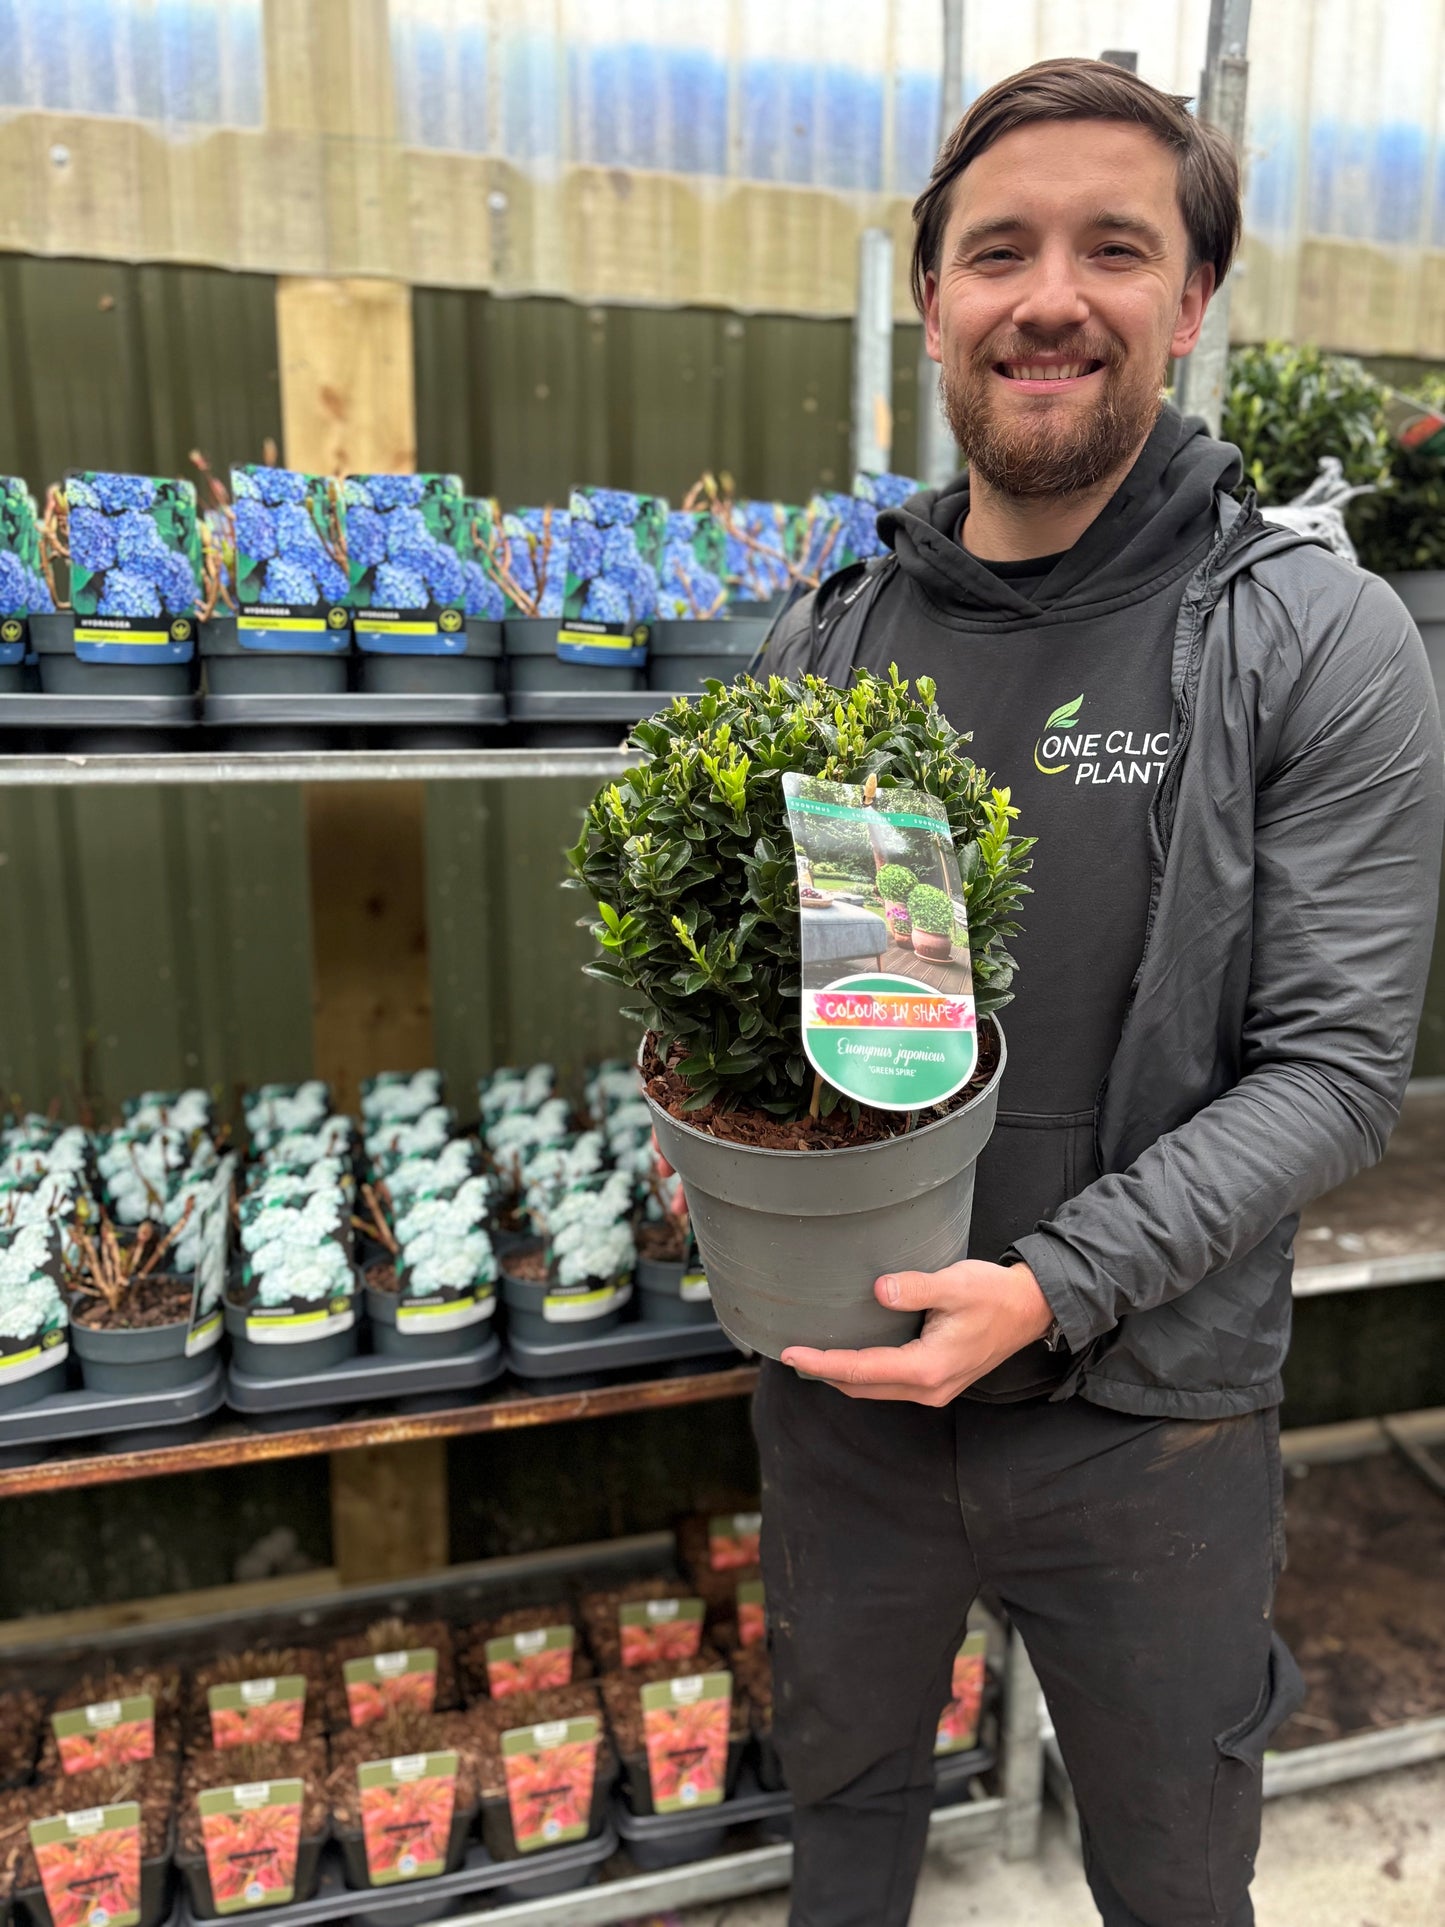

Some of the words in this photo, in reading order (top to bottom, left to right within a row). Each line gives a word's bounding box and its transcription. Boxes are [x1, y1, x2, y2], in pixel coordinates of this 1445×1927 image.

[1042, 733, 1102, 759] ONE
[825, 1001, 888, 1022] COLOURS
[891, 1001, 908, 1022] IN
[912, 1003, 954, 1022] SHAPE
[837, 1037, 893, 1062] Euonymus
[893, 1043, 946, 1067] japonicus
